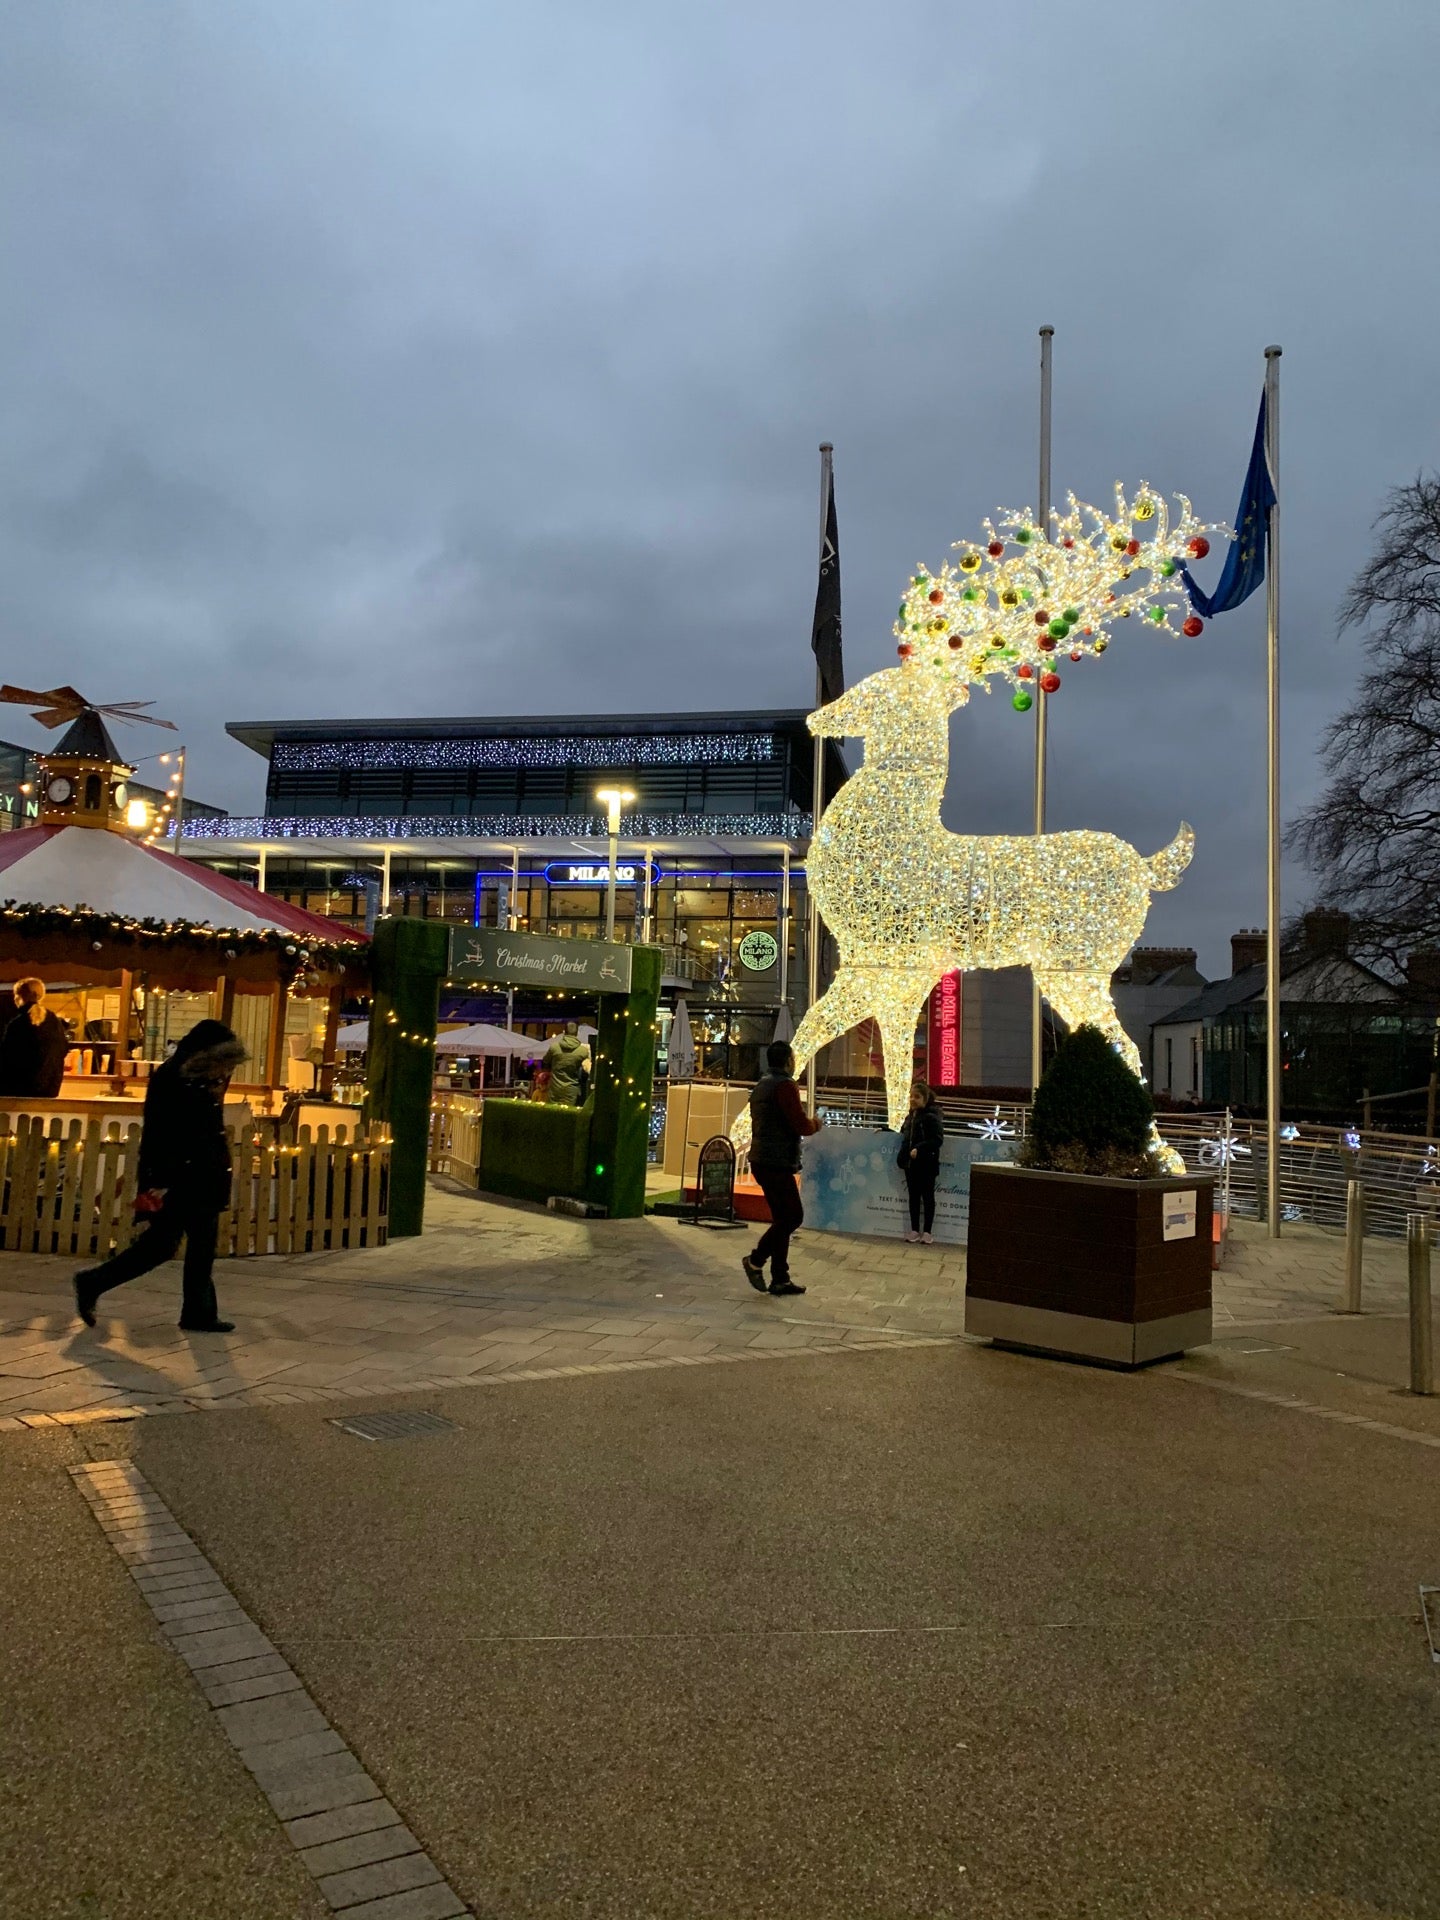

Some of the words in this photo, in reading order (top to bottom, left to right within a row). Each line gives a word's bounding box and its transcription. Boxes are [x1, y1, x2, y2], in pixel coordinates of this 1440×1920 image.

[568, 866, 635, 881] MILANO
[496, 948, 545, 973] Christmas
[545, 953, 588, 975] Market
[744, 947, 773, 955] MILANO
[942, 996, 957, 1028] MILL
[941, 1028, 956, 1086] THEATRE
